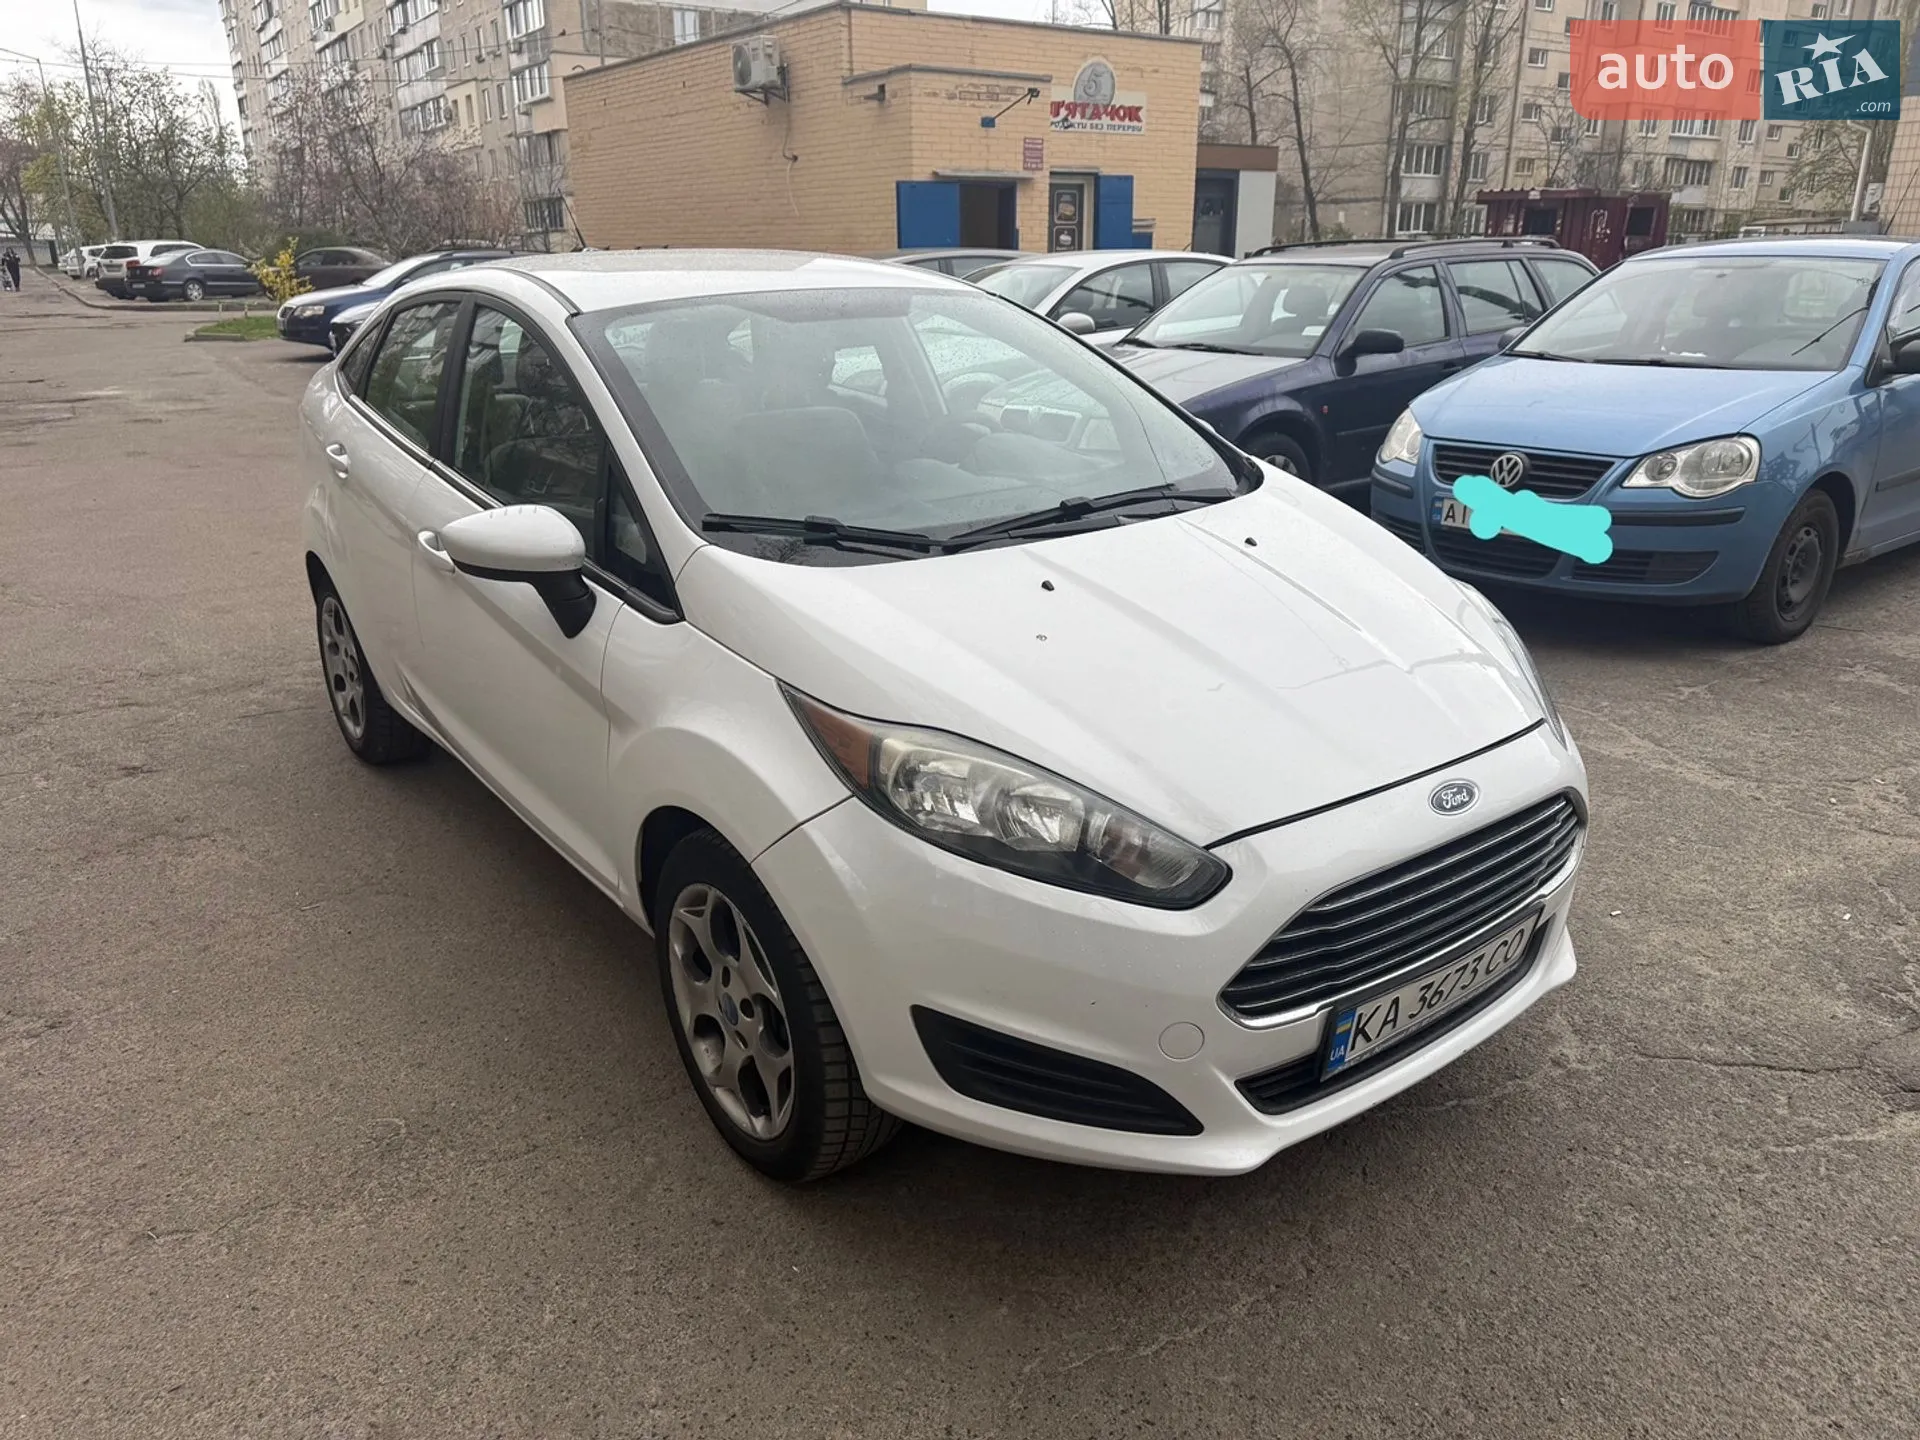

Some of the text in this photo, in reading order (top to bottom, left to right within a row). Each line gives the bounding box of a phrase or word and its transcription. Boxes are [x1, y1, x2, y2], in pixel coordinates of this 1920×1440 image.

[1441, 787, 1469, 809] Ford
[1350, 996, 1400, 1051] KA
[1408, 952, 1486, 1019] 3673
[1485, 928, 1525, 975] CO
[1330, 1045, 1345, 1061] UA
